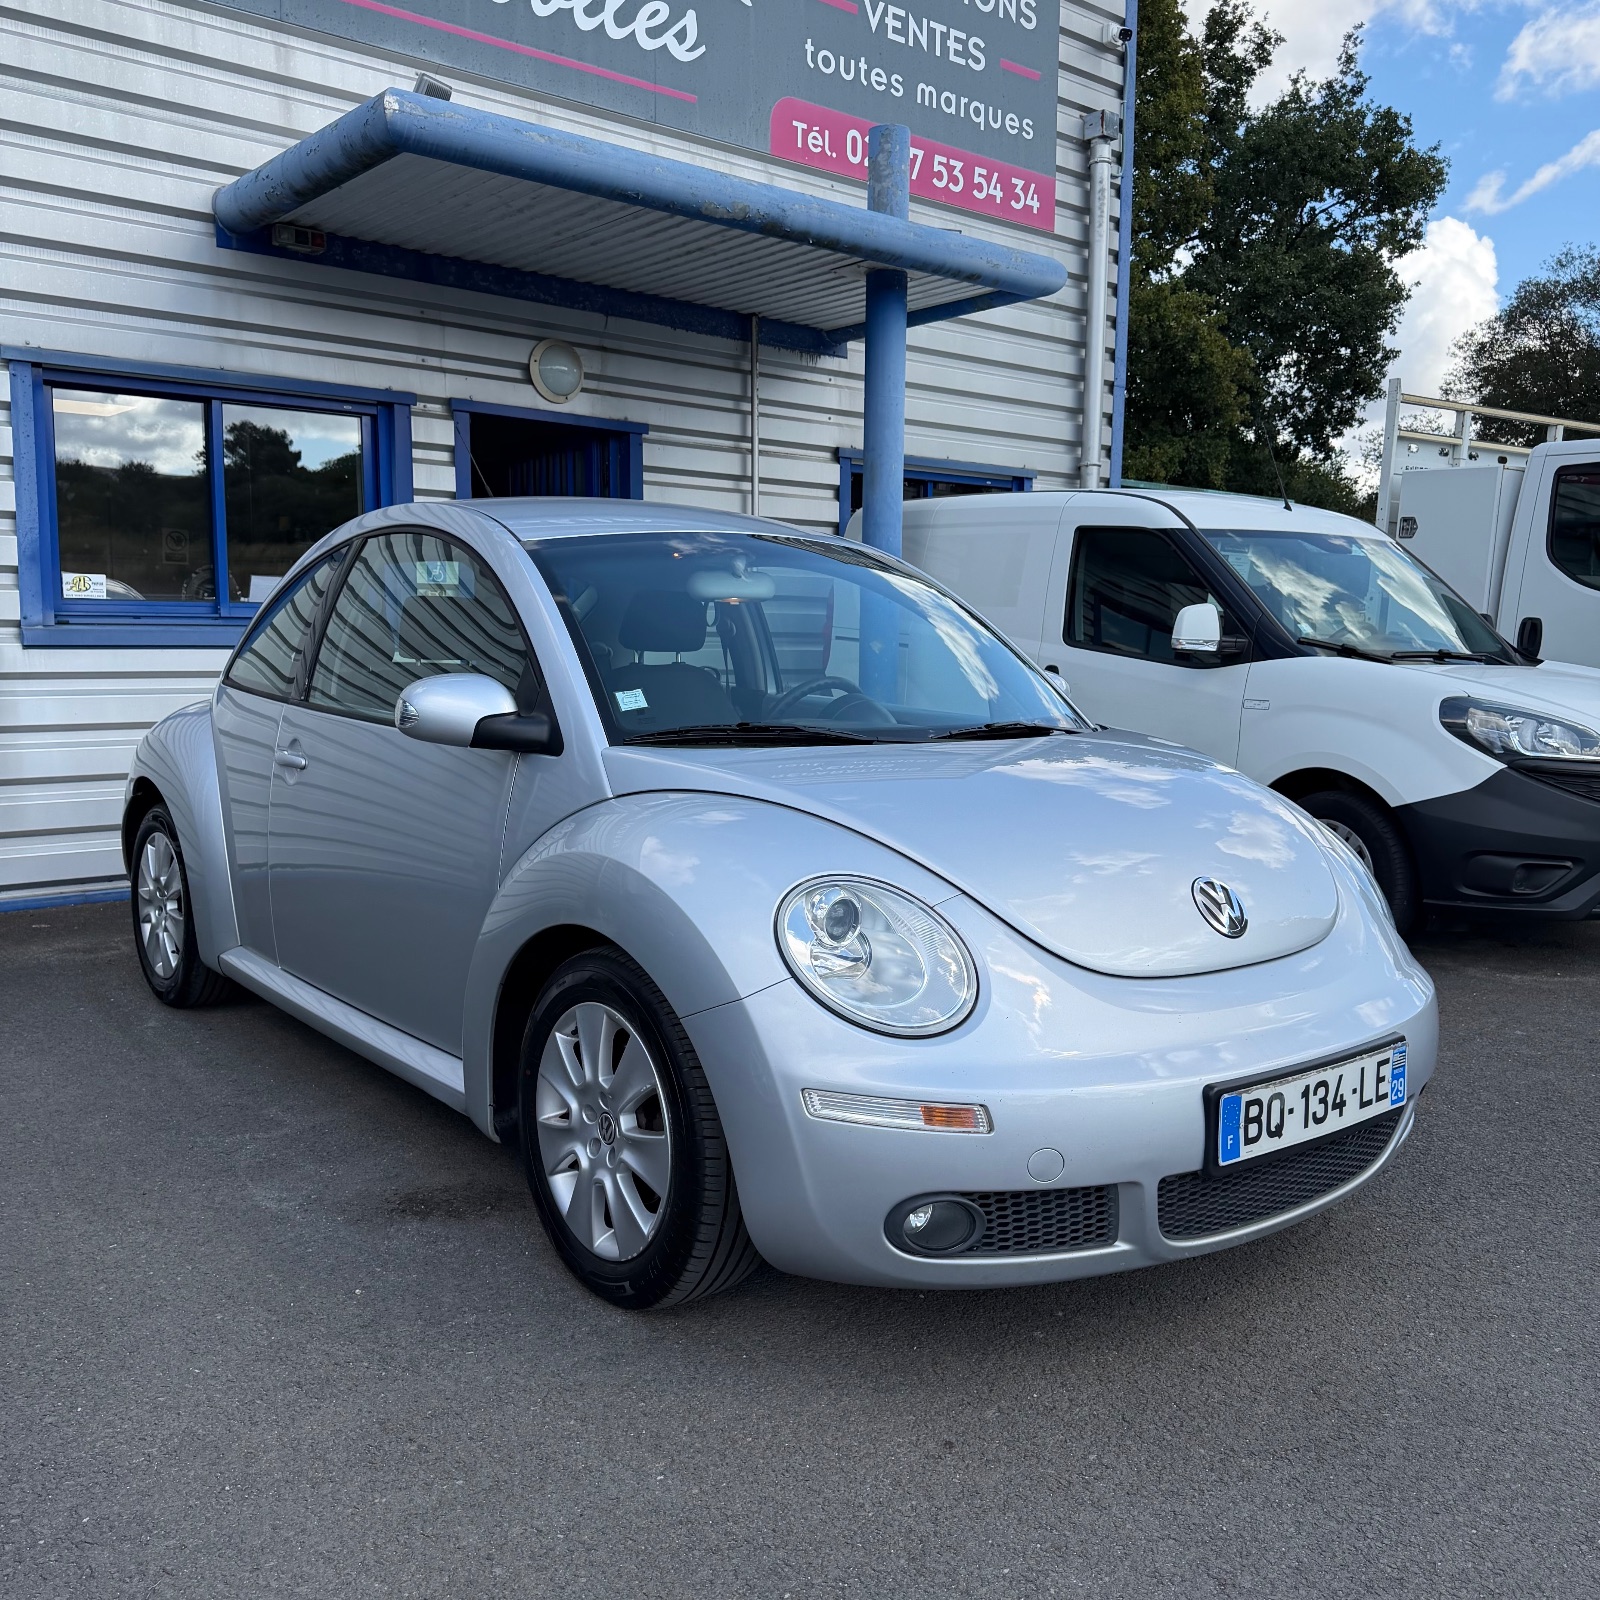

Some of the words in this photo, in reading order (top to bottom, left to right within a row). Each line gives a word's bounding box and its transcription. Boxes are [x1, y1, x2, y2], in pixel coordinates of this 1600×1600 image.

[864, 0, 986, 71] VENTES
[805, 38, 904, 97] toutes
[917, 82, 1034, 140] marques
[792, 120, 837, 159] Tél.
[846, 129, 869, 168] 0
[932, 154, 965, 193] 53
[973, 166, 1003, 204] 54
[1010, 177, 1040, 214] 34
[1227, 1135, 1234, 1150] F
[1243, 1057, 1391, 1147] BQ-134-LE
[1391, 1077, 1405, 1101] 29
